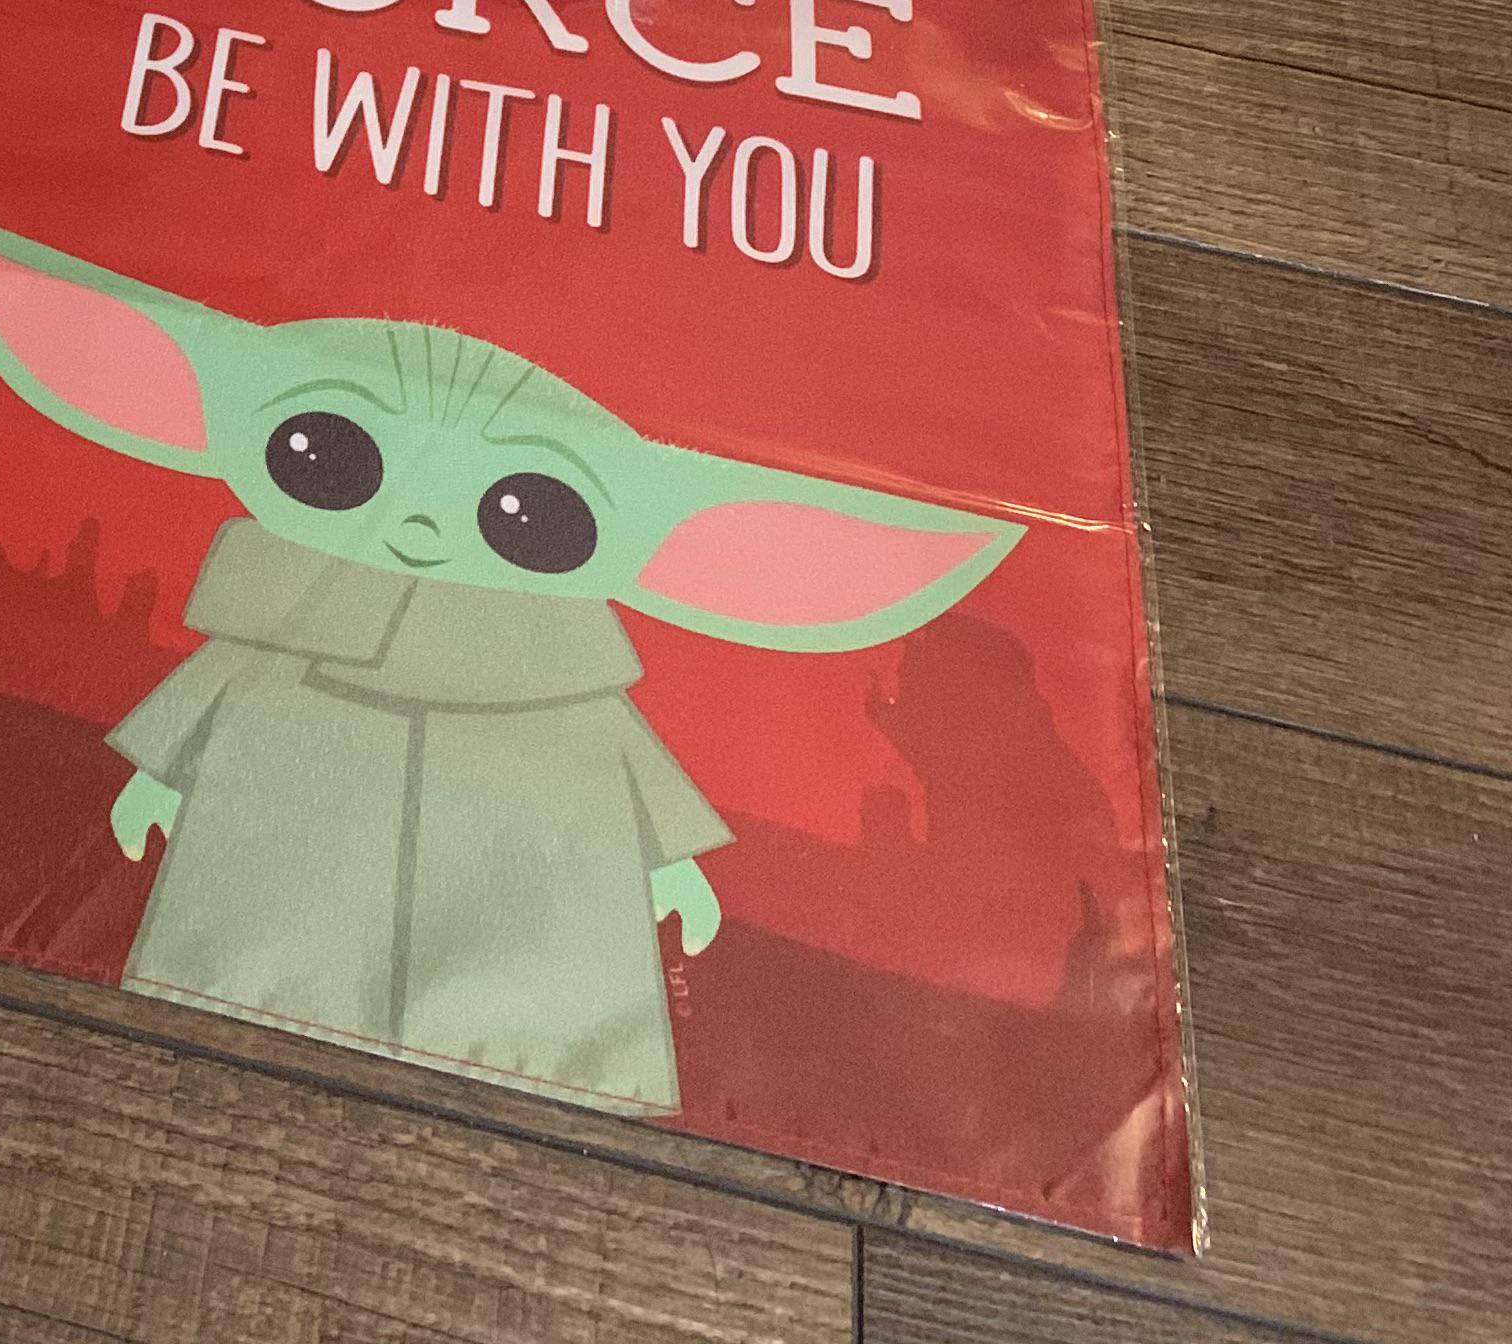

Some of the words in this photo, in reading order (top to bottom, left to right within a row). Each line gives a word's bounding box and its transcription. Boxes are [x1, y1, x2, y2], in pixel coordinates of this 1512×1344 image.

[121, 12, 273, 157] BE
[314, 48, 611, 229] WITH
[662, 115, 875, 283] YOU
